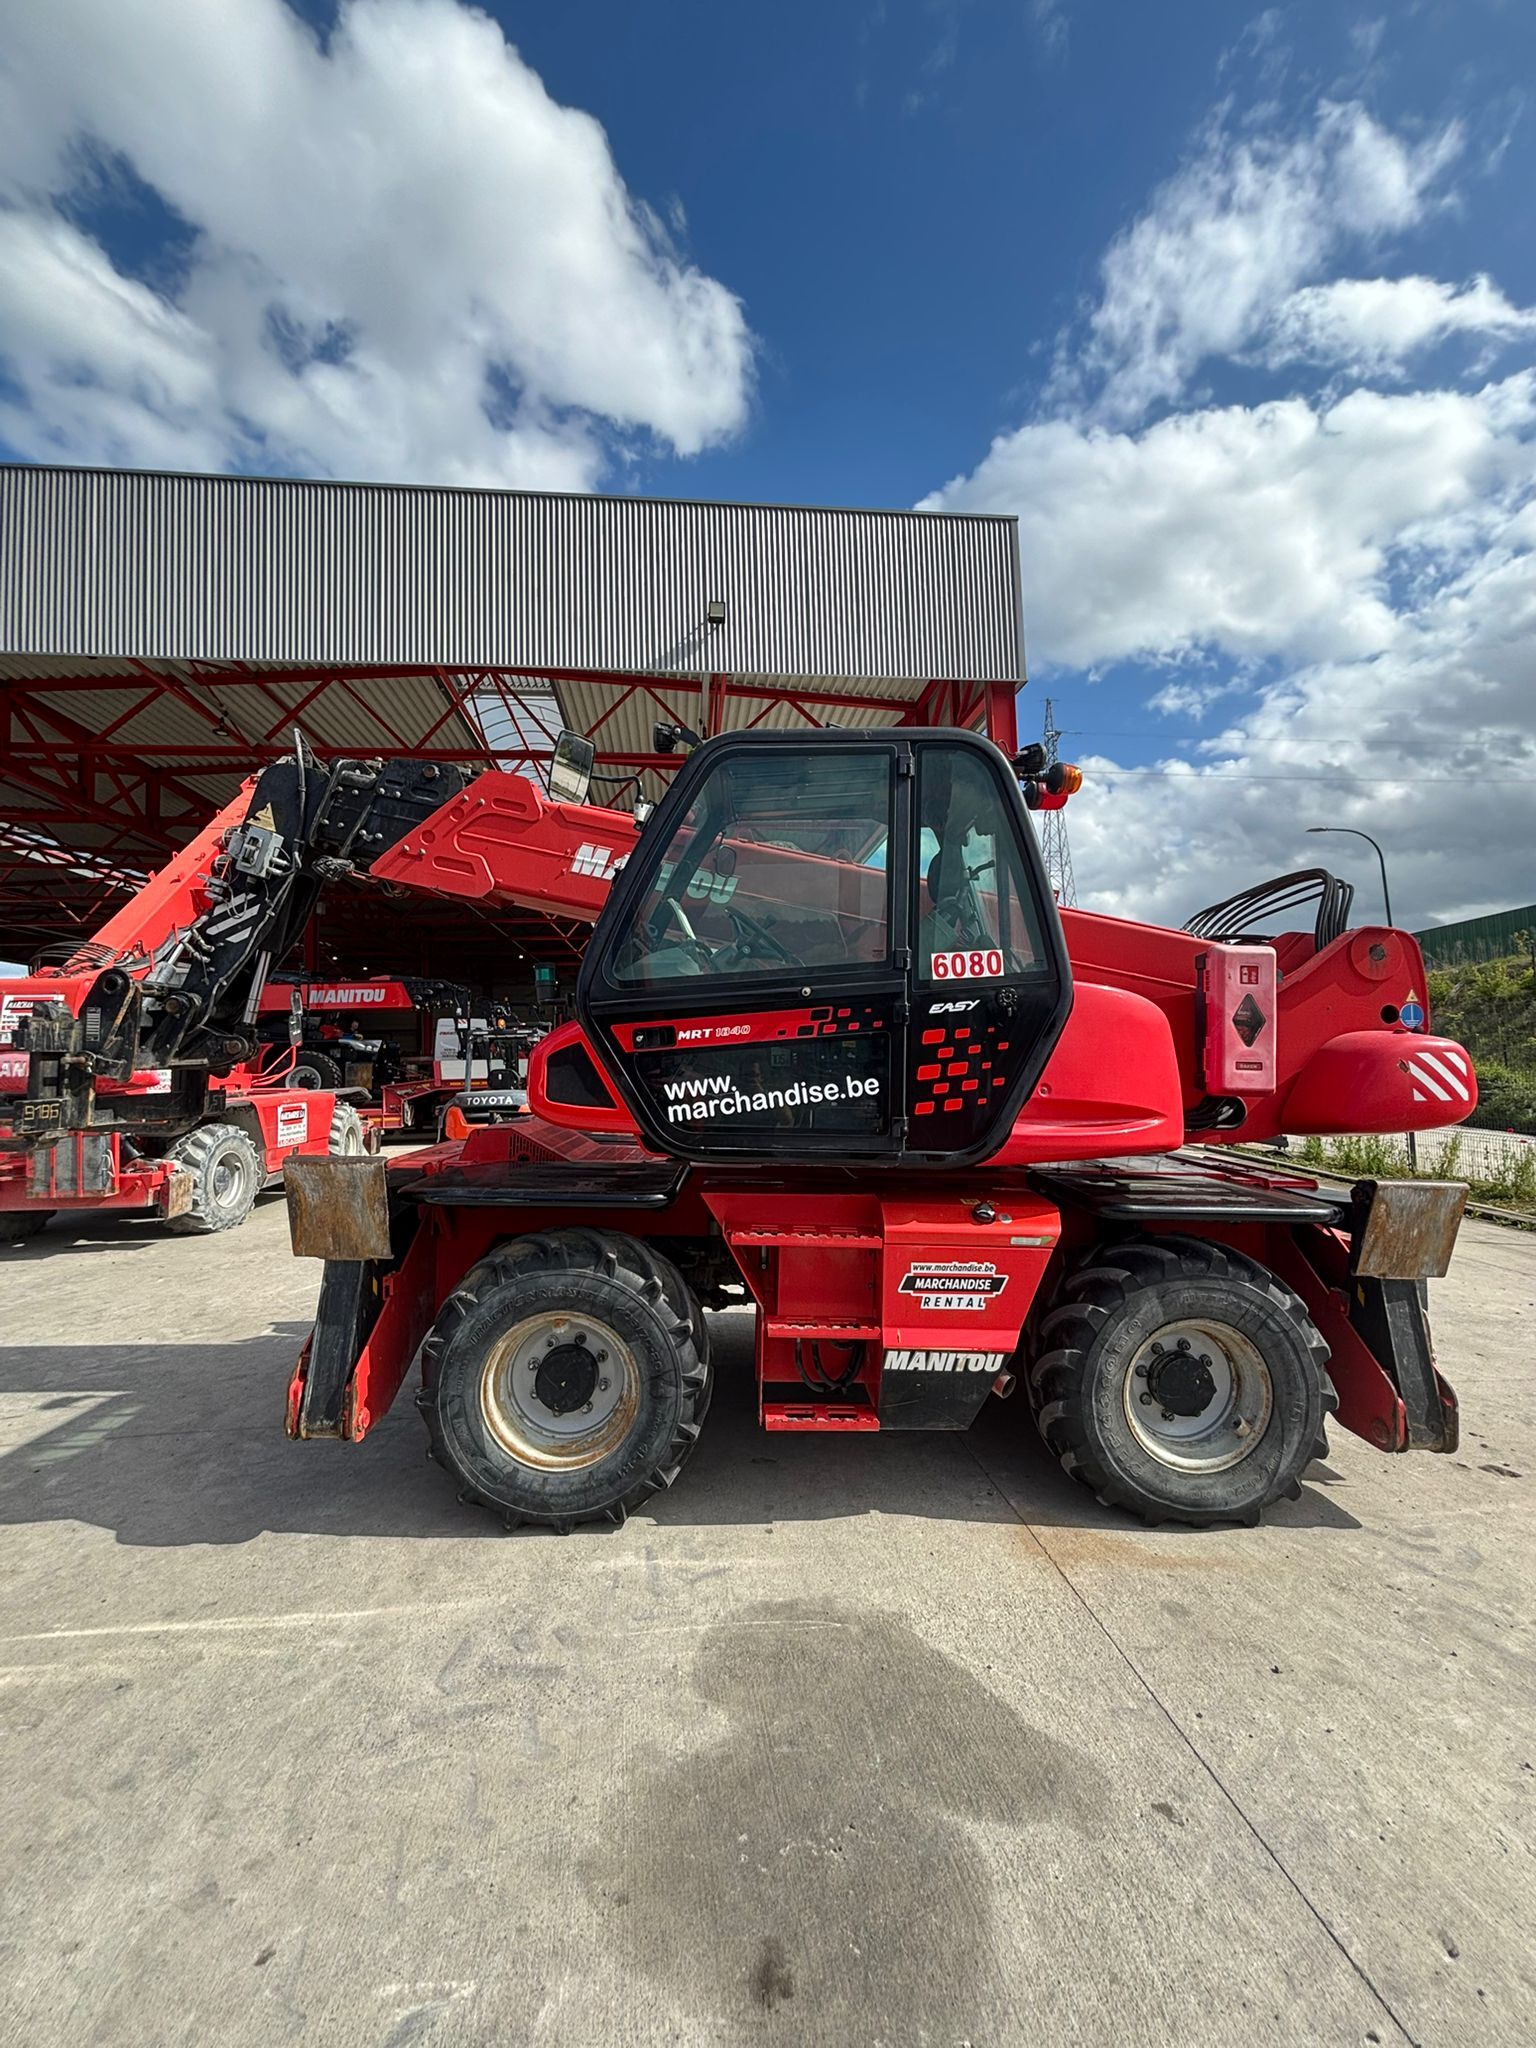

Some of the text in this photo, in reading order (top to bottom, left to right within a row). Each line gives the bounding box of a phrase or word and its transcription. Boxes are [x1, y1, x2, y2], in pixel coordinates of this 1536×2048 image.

[933, 950, 1002, 979] 6080
[309, 988, 386, 1004] MANITOU
[929, 999, 981, 1014] EASY
[678, 1024, 751, 1041] MRT 1840
[664, 1075, 737, 1101] www.
[466, 1095, 514, 1106] TOYOTA
[667, 1075, 880, 1123] marchandise.be
[912, 1263, 994, 1272] www.marchandise.be
[915, 1278, 992, 1290] MARCHANDISE
[923, 1296, 984, 1308] RENTAL
[884, 1350, 1004, 1372] MANITOU
